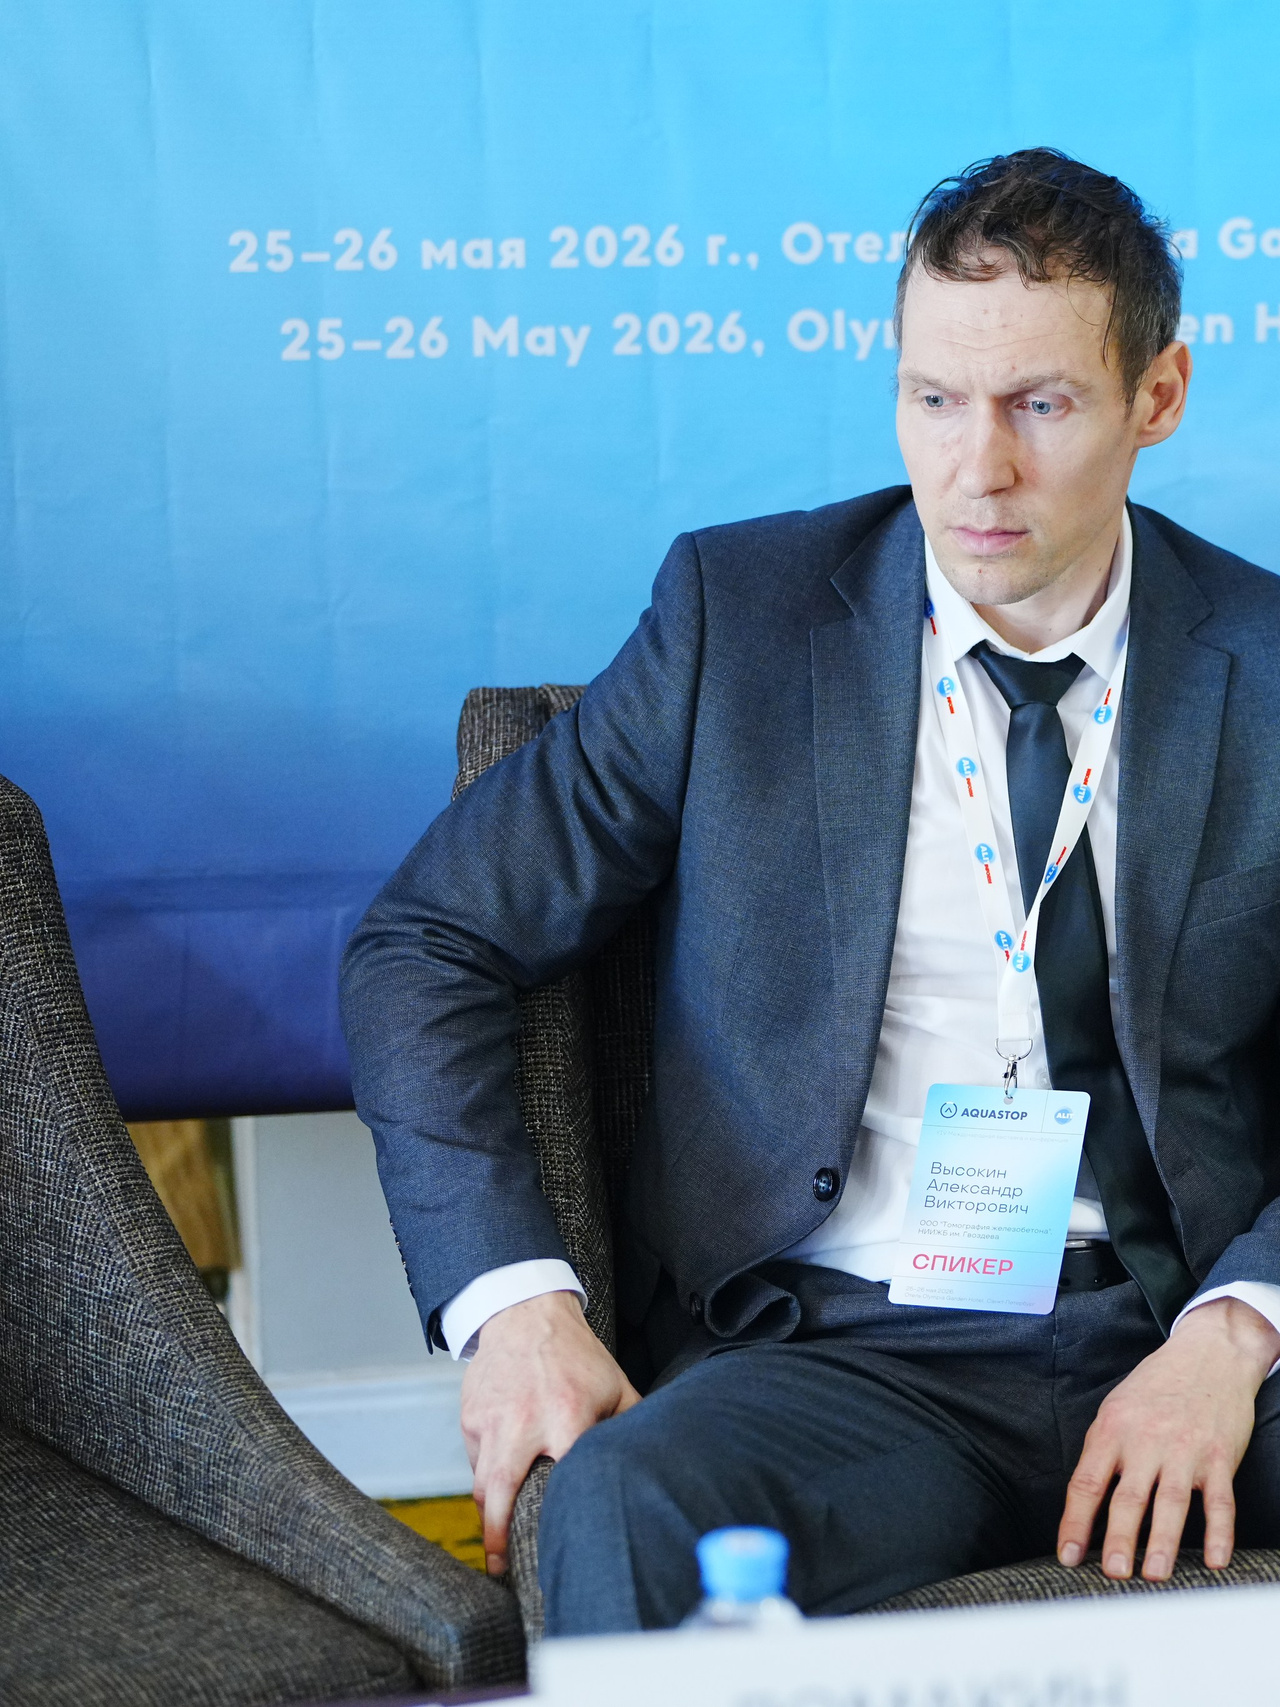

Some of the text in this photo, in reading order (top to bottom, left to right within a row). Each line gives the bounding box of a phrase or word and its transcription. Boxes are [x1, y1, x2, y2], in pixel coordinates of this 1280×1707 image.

[228, 228, 398, 272] 25–26
[421, 237, 526, 269] мая
[549, 225, 684, 268] 2026
[706, 233, 759, 270] г.,
[280, 318, 448, 360] 25–26
[473, 316, 590, 366] May
[612, 312, 764, 357] 2026,
[960, 1107, 1028, 1121] AQUASTOP
[930, 1161, 1007, 1179] Высокин
[926, 1178, 1023, 1199] Александр
[924, 1195, 1029, 1214] Викторович
[919, 1219, 939, 1228] ООО
[962, 1231, 1000, 1240] Гвоздева
[912, 1253, 1014, 1276] СПИКЕР
